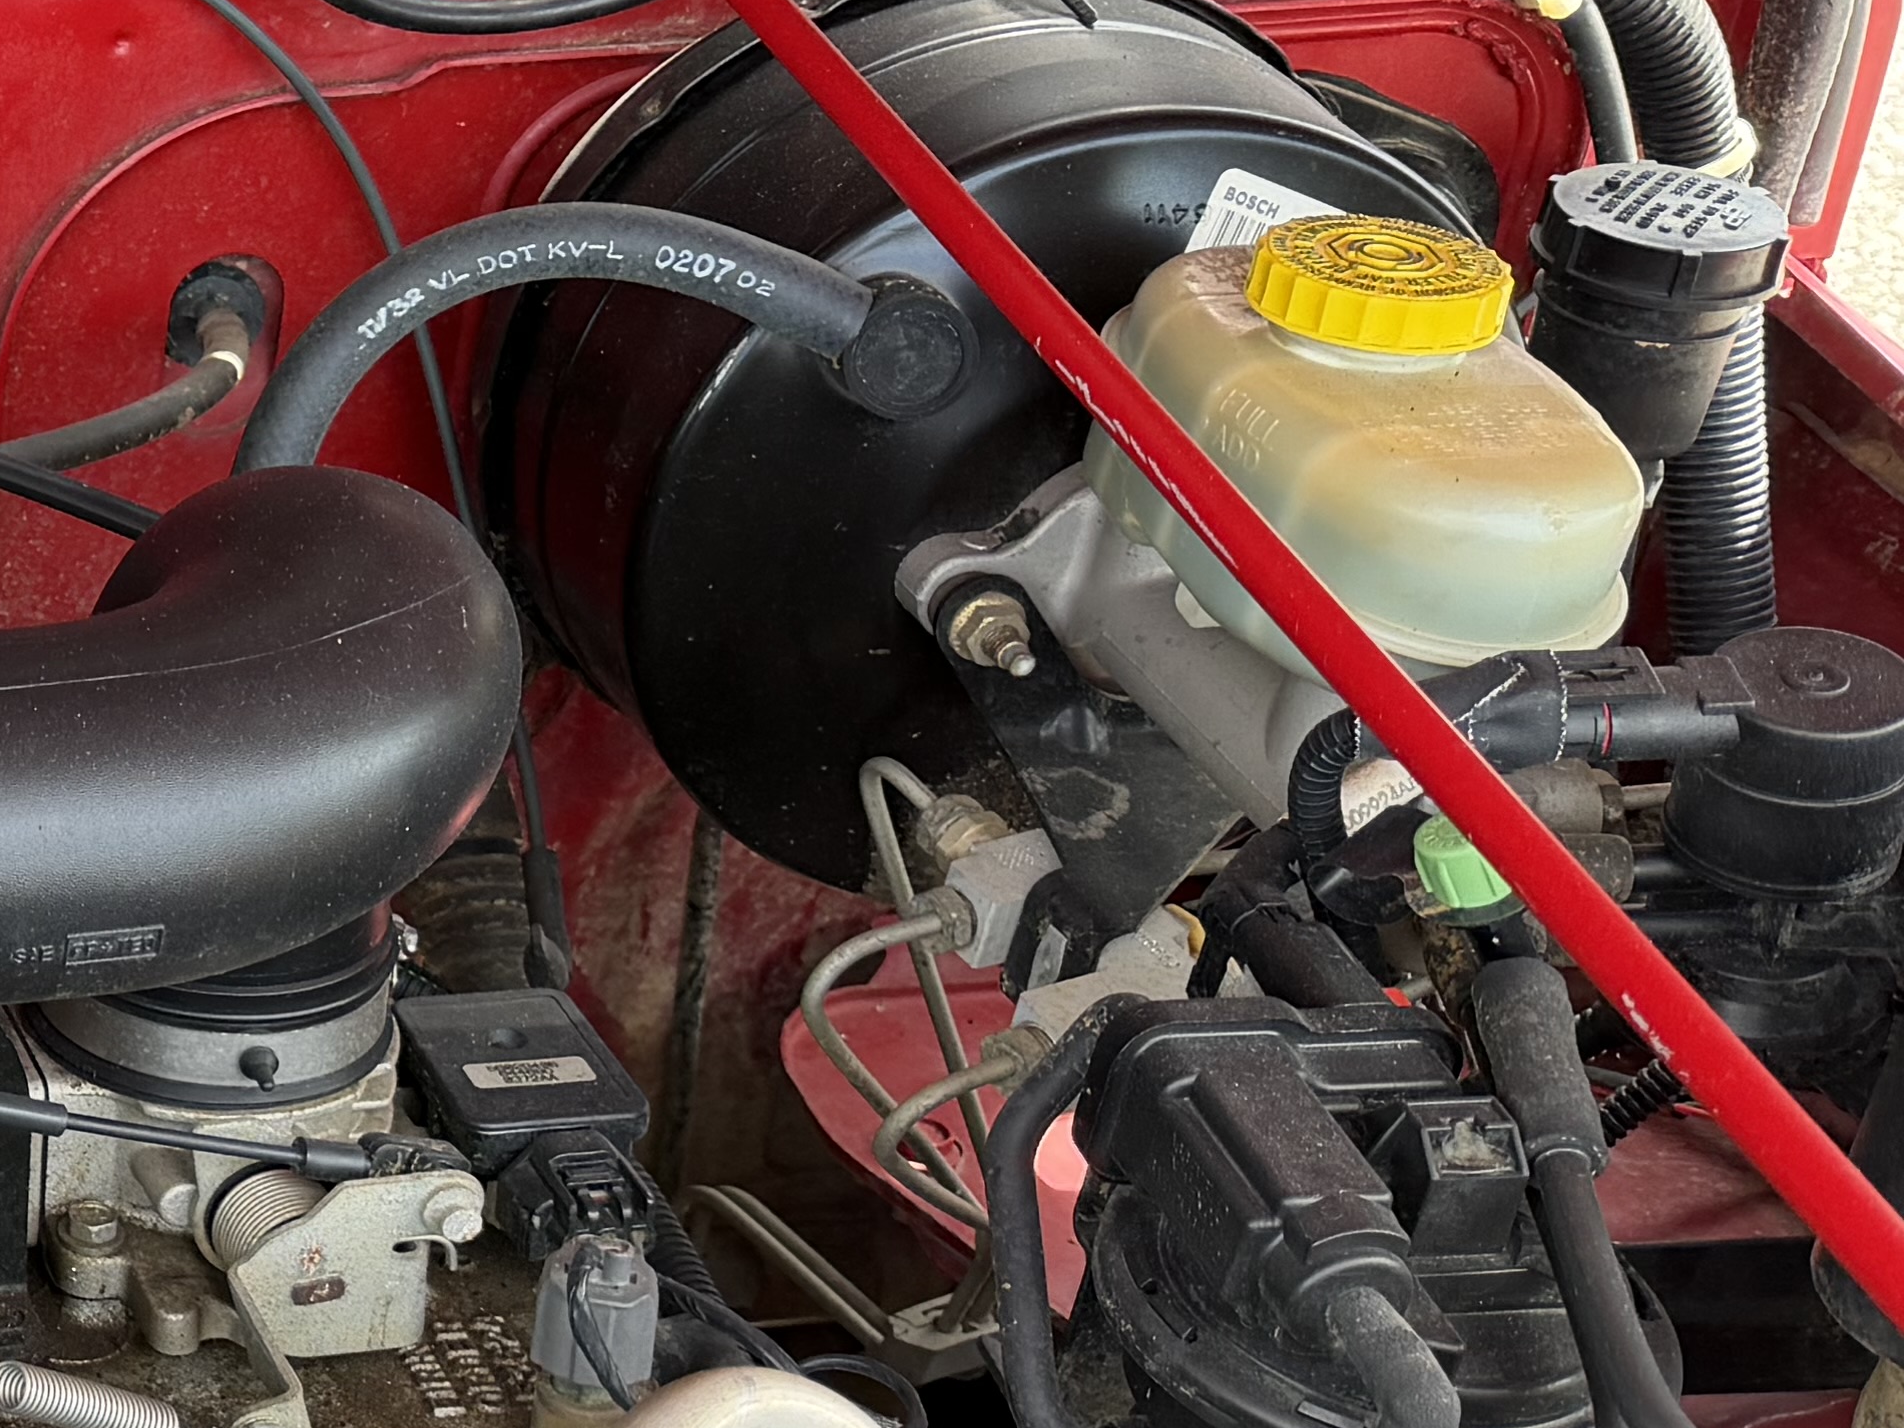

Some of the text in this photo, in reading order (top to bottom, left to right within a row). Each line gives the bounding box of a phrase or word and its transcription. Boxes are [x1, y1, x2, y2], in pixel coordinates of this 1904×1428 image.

[1222, 185, 1282, 221] BOSCH
[476, 243, 539, 277] DOT
[1218, 388, 1280, 452] FULL
[1211, 423, 1262, 470] ADD
